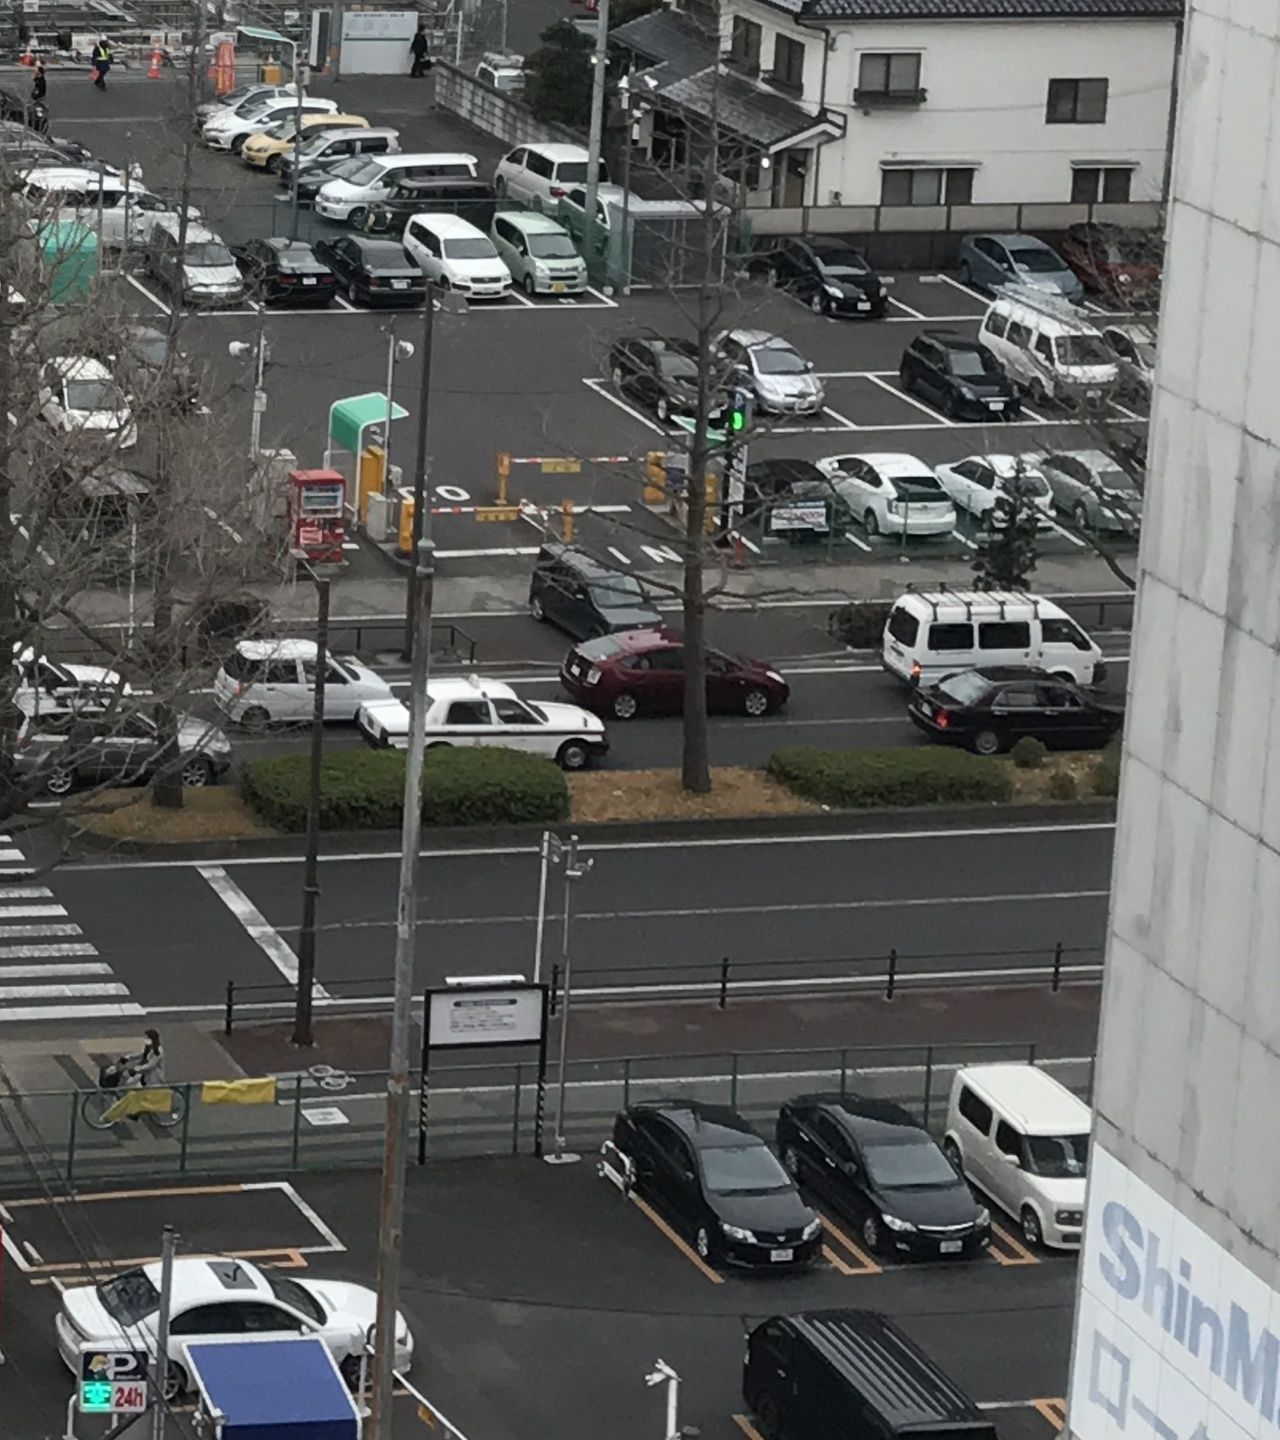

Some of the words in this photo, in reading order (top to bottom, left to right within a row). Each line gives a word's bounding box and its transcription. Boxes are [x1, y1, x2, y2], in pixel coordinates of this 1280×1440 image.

[1099, 1200, 1280, 1424] ShinM
[106, 1353, 138, 1380] P
[114, 1386, 143, 1408] 24h
